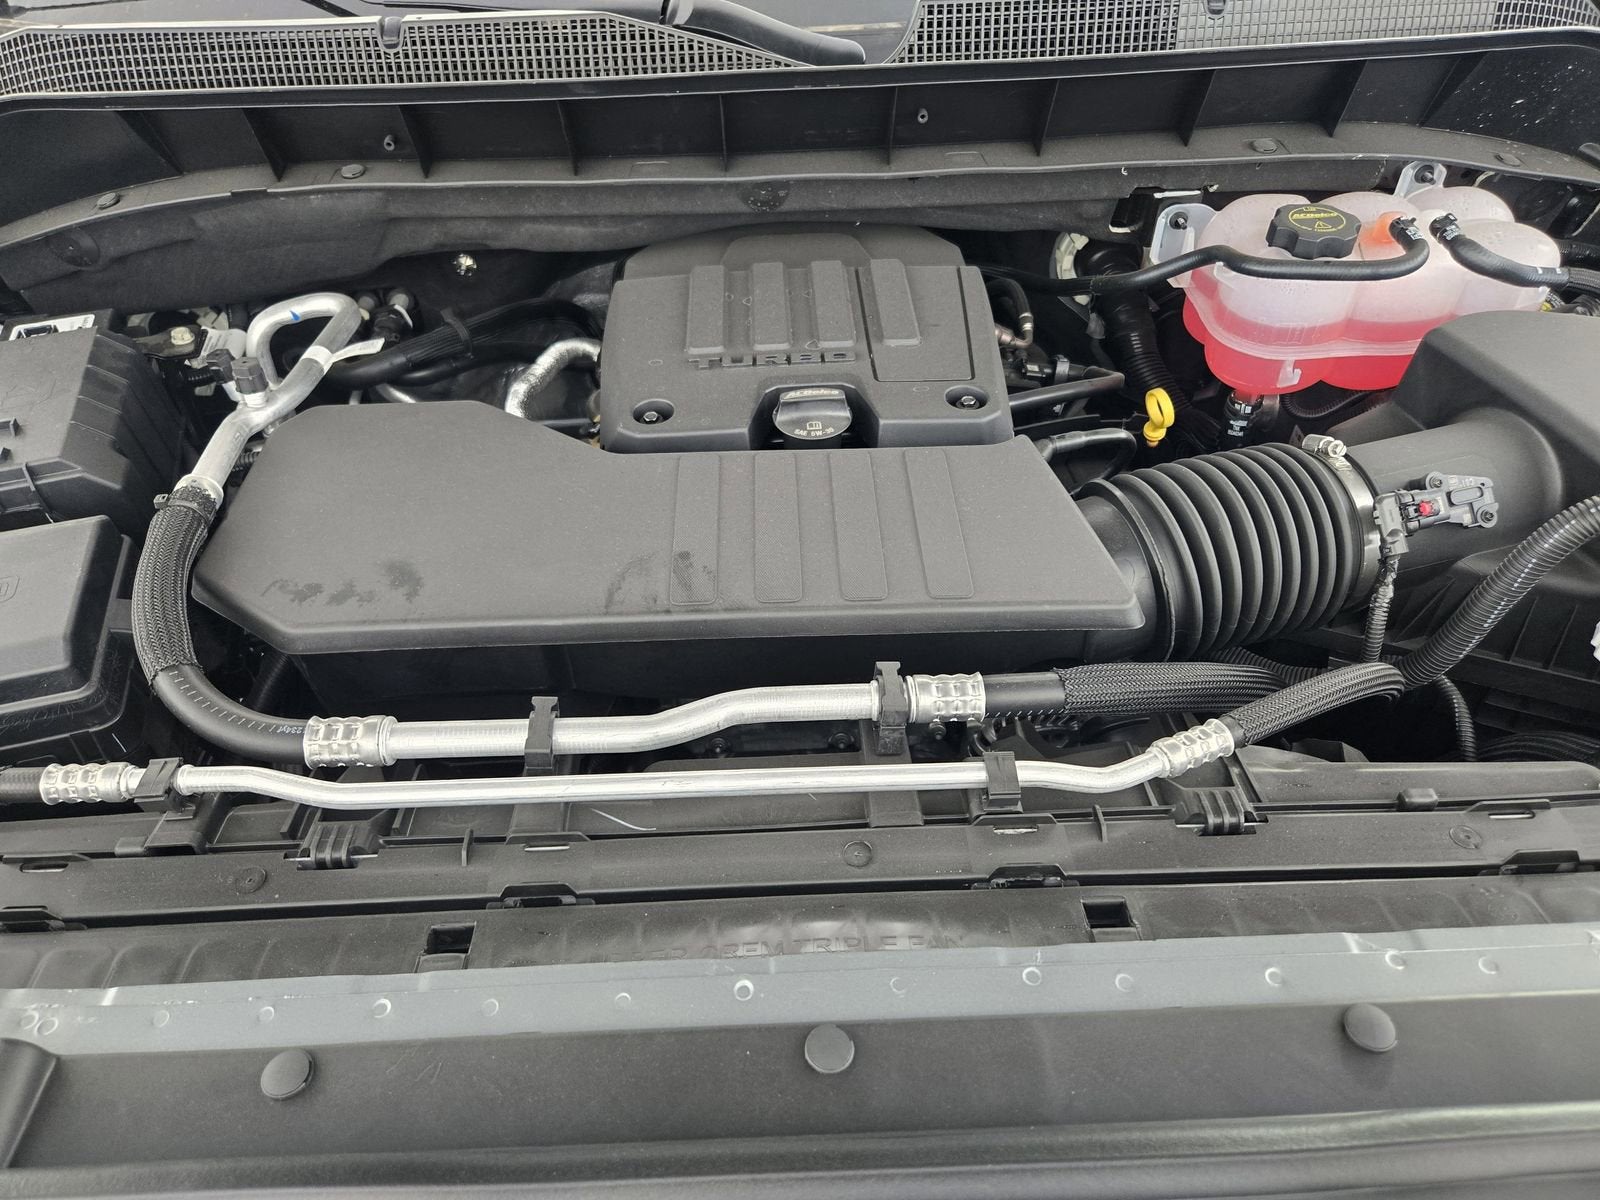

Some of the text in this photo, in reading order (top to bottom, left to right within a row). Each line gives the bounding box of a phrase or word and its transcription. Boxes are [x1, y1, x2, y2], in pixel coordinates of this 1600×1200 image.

[688, 352, 857, 368] TURBO
[783, 388, 840, 400] ACDelco
[793, 428, 808, 436] SAE
